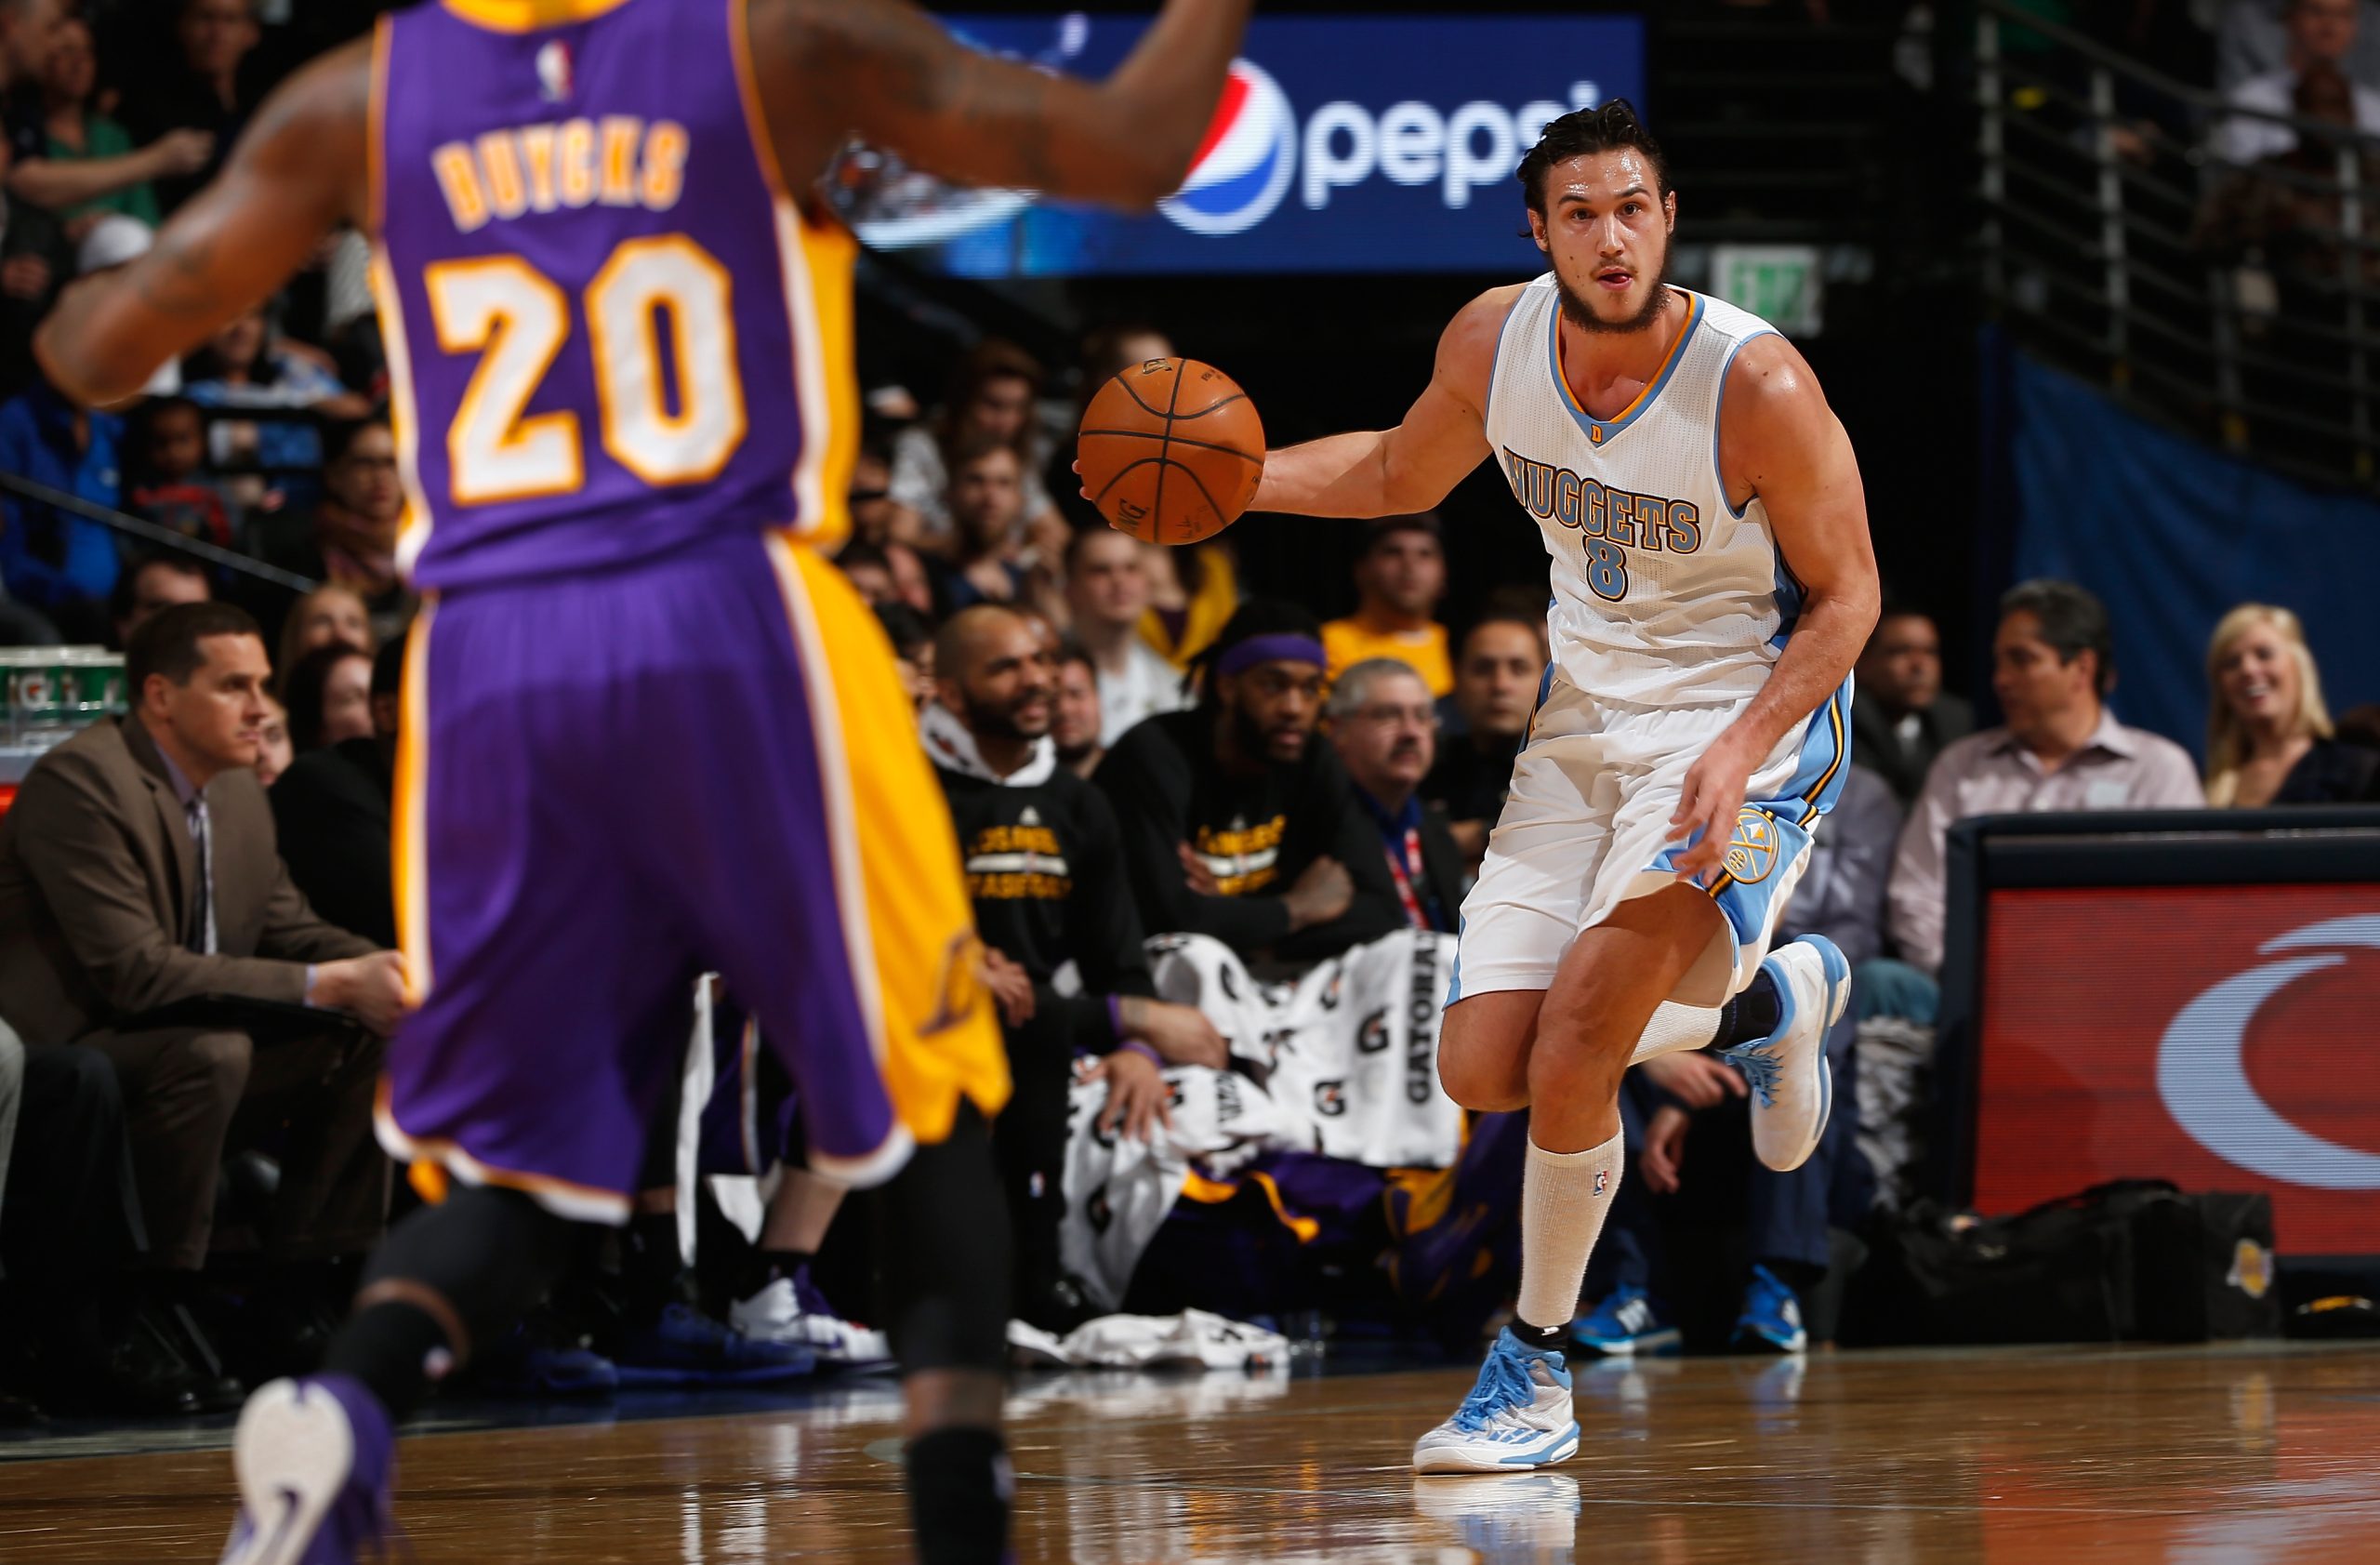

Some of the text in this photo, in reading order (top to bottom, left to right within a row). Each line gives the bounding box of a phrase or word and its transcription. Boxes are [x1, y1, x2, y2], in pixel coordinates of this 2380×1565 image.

[1302, 80, 1600, 210] pep
[422, 231, 749, 508] 20
[1591, 423, 1604, 444] D
[1502, 444, 1702, 555] NUGGETS
[1582, 534, 1630, 603] 8
[1356, 1004, 1391, 1055] G
